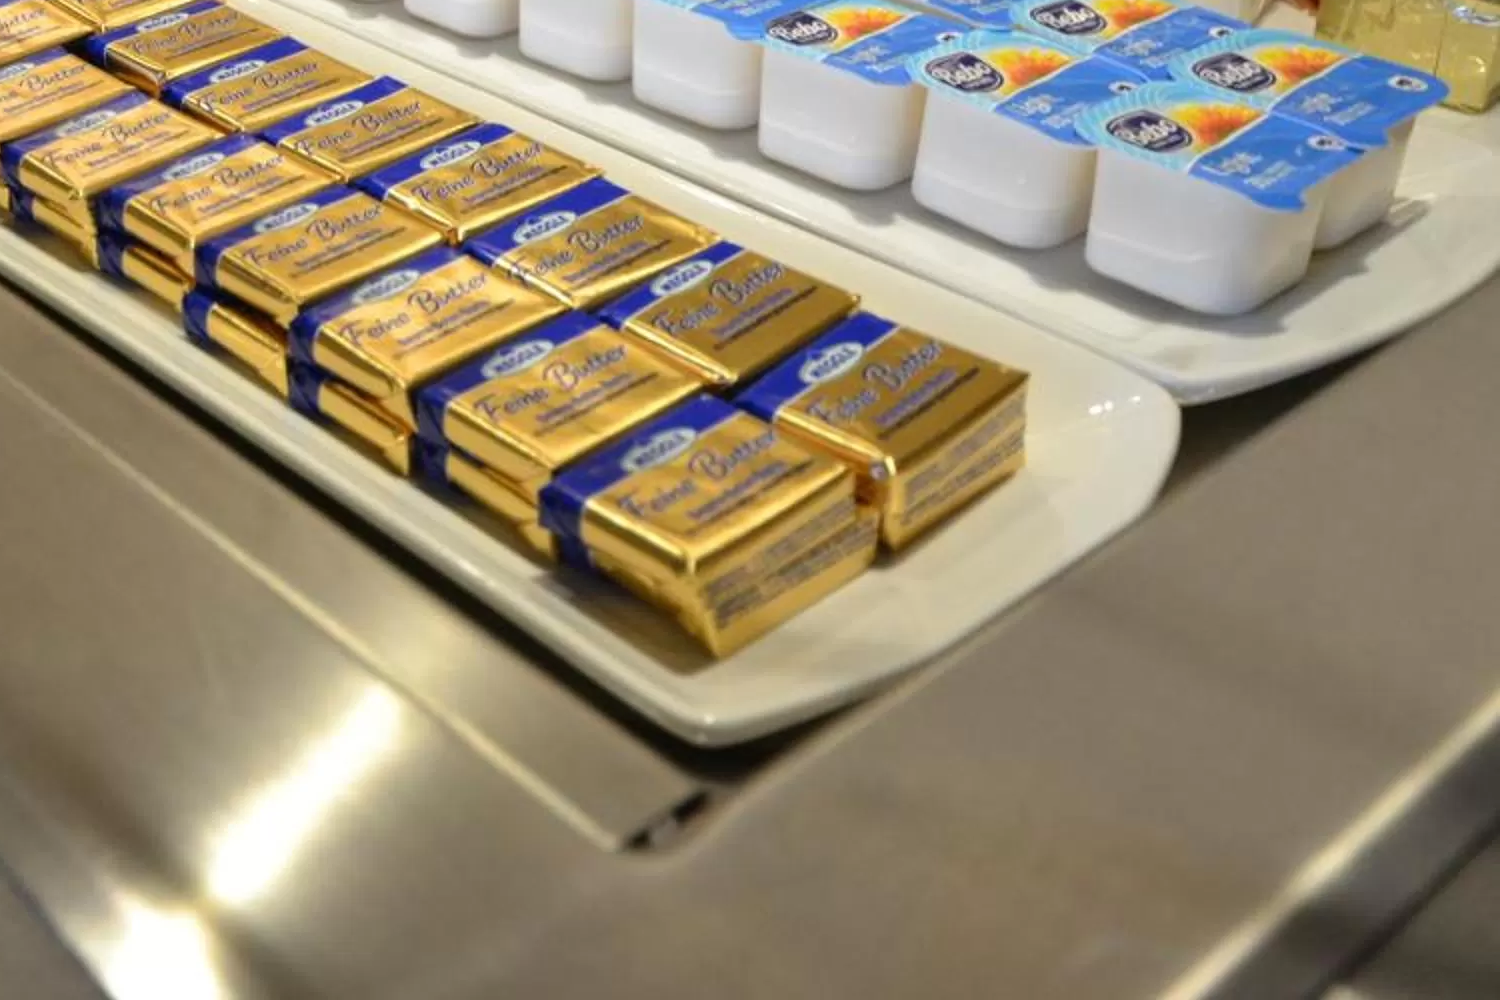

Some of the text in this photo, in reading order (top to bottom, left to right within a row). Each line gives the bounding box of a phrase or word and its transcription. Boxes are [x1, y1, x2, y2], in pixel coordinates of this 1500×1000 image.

[101, 113, 171, 145] Butter
[211, 155, 286, 187] Butter
[411, 175, 476, 202] Feine
[470, 141, 544, 178] Butter
[242, 236, 309, 266] Feine
[305, 202, 384, 241] Butter
[567, 215, 645, 252] Butter
[339, 311, 411, 347] Feine
[407, 272, 488, 314] Butter
[651, 299, 722, 336] Feine
[708, 262, 786, 305] Butter
[473, 387, 550, 424] Feine
[542, 343, 629, 392] Butter
[861, 339, 944, 393] Butter
[687, 428, 778, 480] Butter
